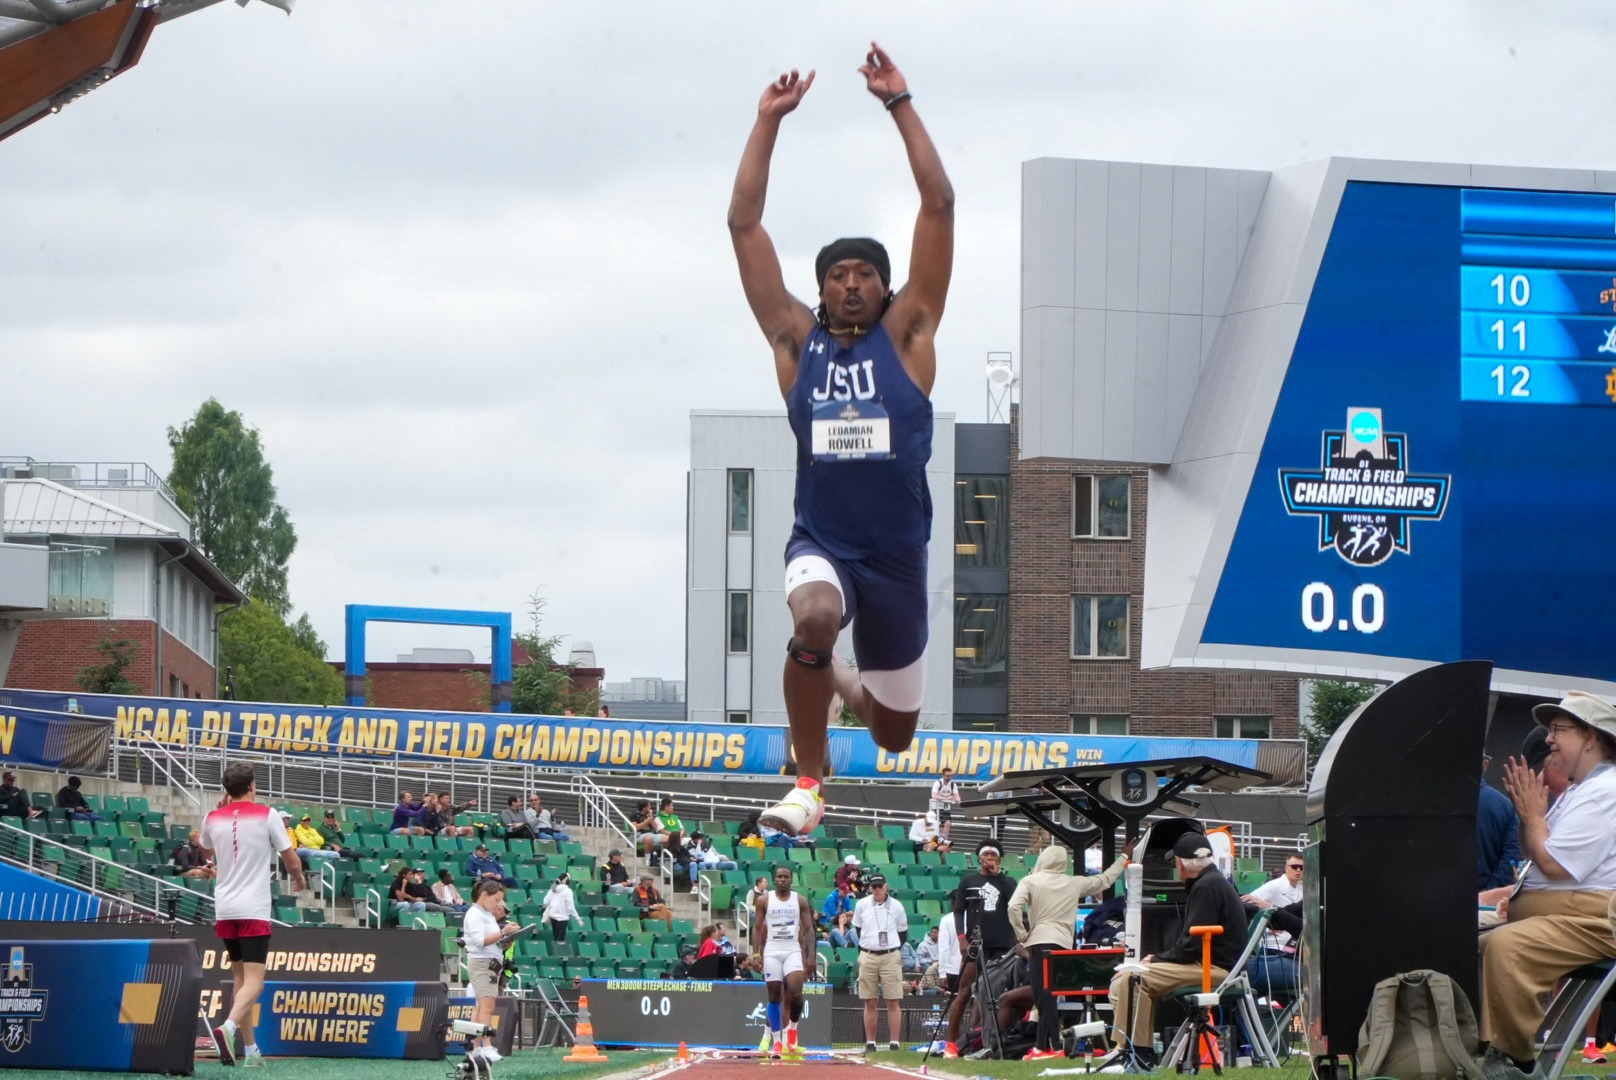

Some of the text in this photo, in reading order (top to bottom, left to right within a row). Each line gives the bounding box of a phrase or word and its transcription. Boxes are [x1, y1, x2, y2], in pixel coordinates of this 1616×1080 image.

[1490, 273, 1530, 306] 10
[1490, 319, 1527, 351] 11
[813, 360, 876, 401] JSU
[1490, 365, 1530, 397] 12
[828, 426, 873, 436] LEDAMIAN
[828, 438, 873, 450] ROWELL
[1325, 468, 1404, 484] TRACK & FIELD
[1294, 482, 1436, 508] CHAMPIONSHIPS
[1301, 582, 1384, 633] 0.0
[115, 706, 746, 769] NCAA DI TRACK AND FIELD CHAMPIONSHIPS
[876, 738, 1069, 775] CHAMPIONS
[1076, 748, 1103, 760] WIN
[220, 950, 376, 973] CMPIONSHIPS
[607, 980, 621, 990] MEN
[620, 980, 642, 990] 3000M
[642, 980, 687, 992] STEEPLECHASE
[690, 981, 713, 992] FINALS
[272, 990, 385, 1017] CHAMPIONS
[641, 996, 671, 1016] 0.0
[280, 1018, 370, 1044] WIN HERE
